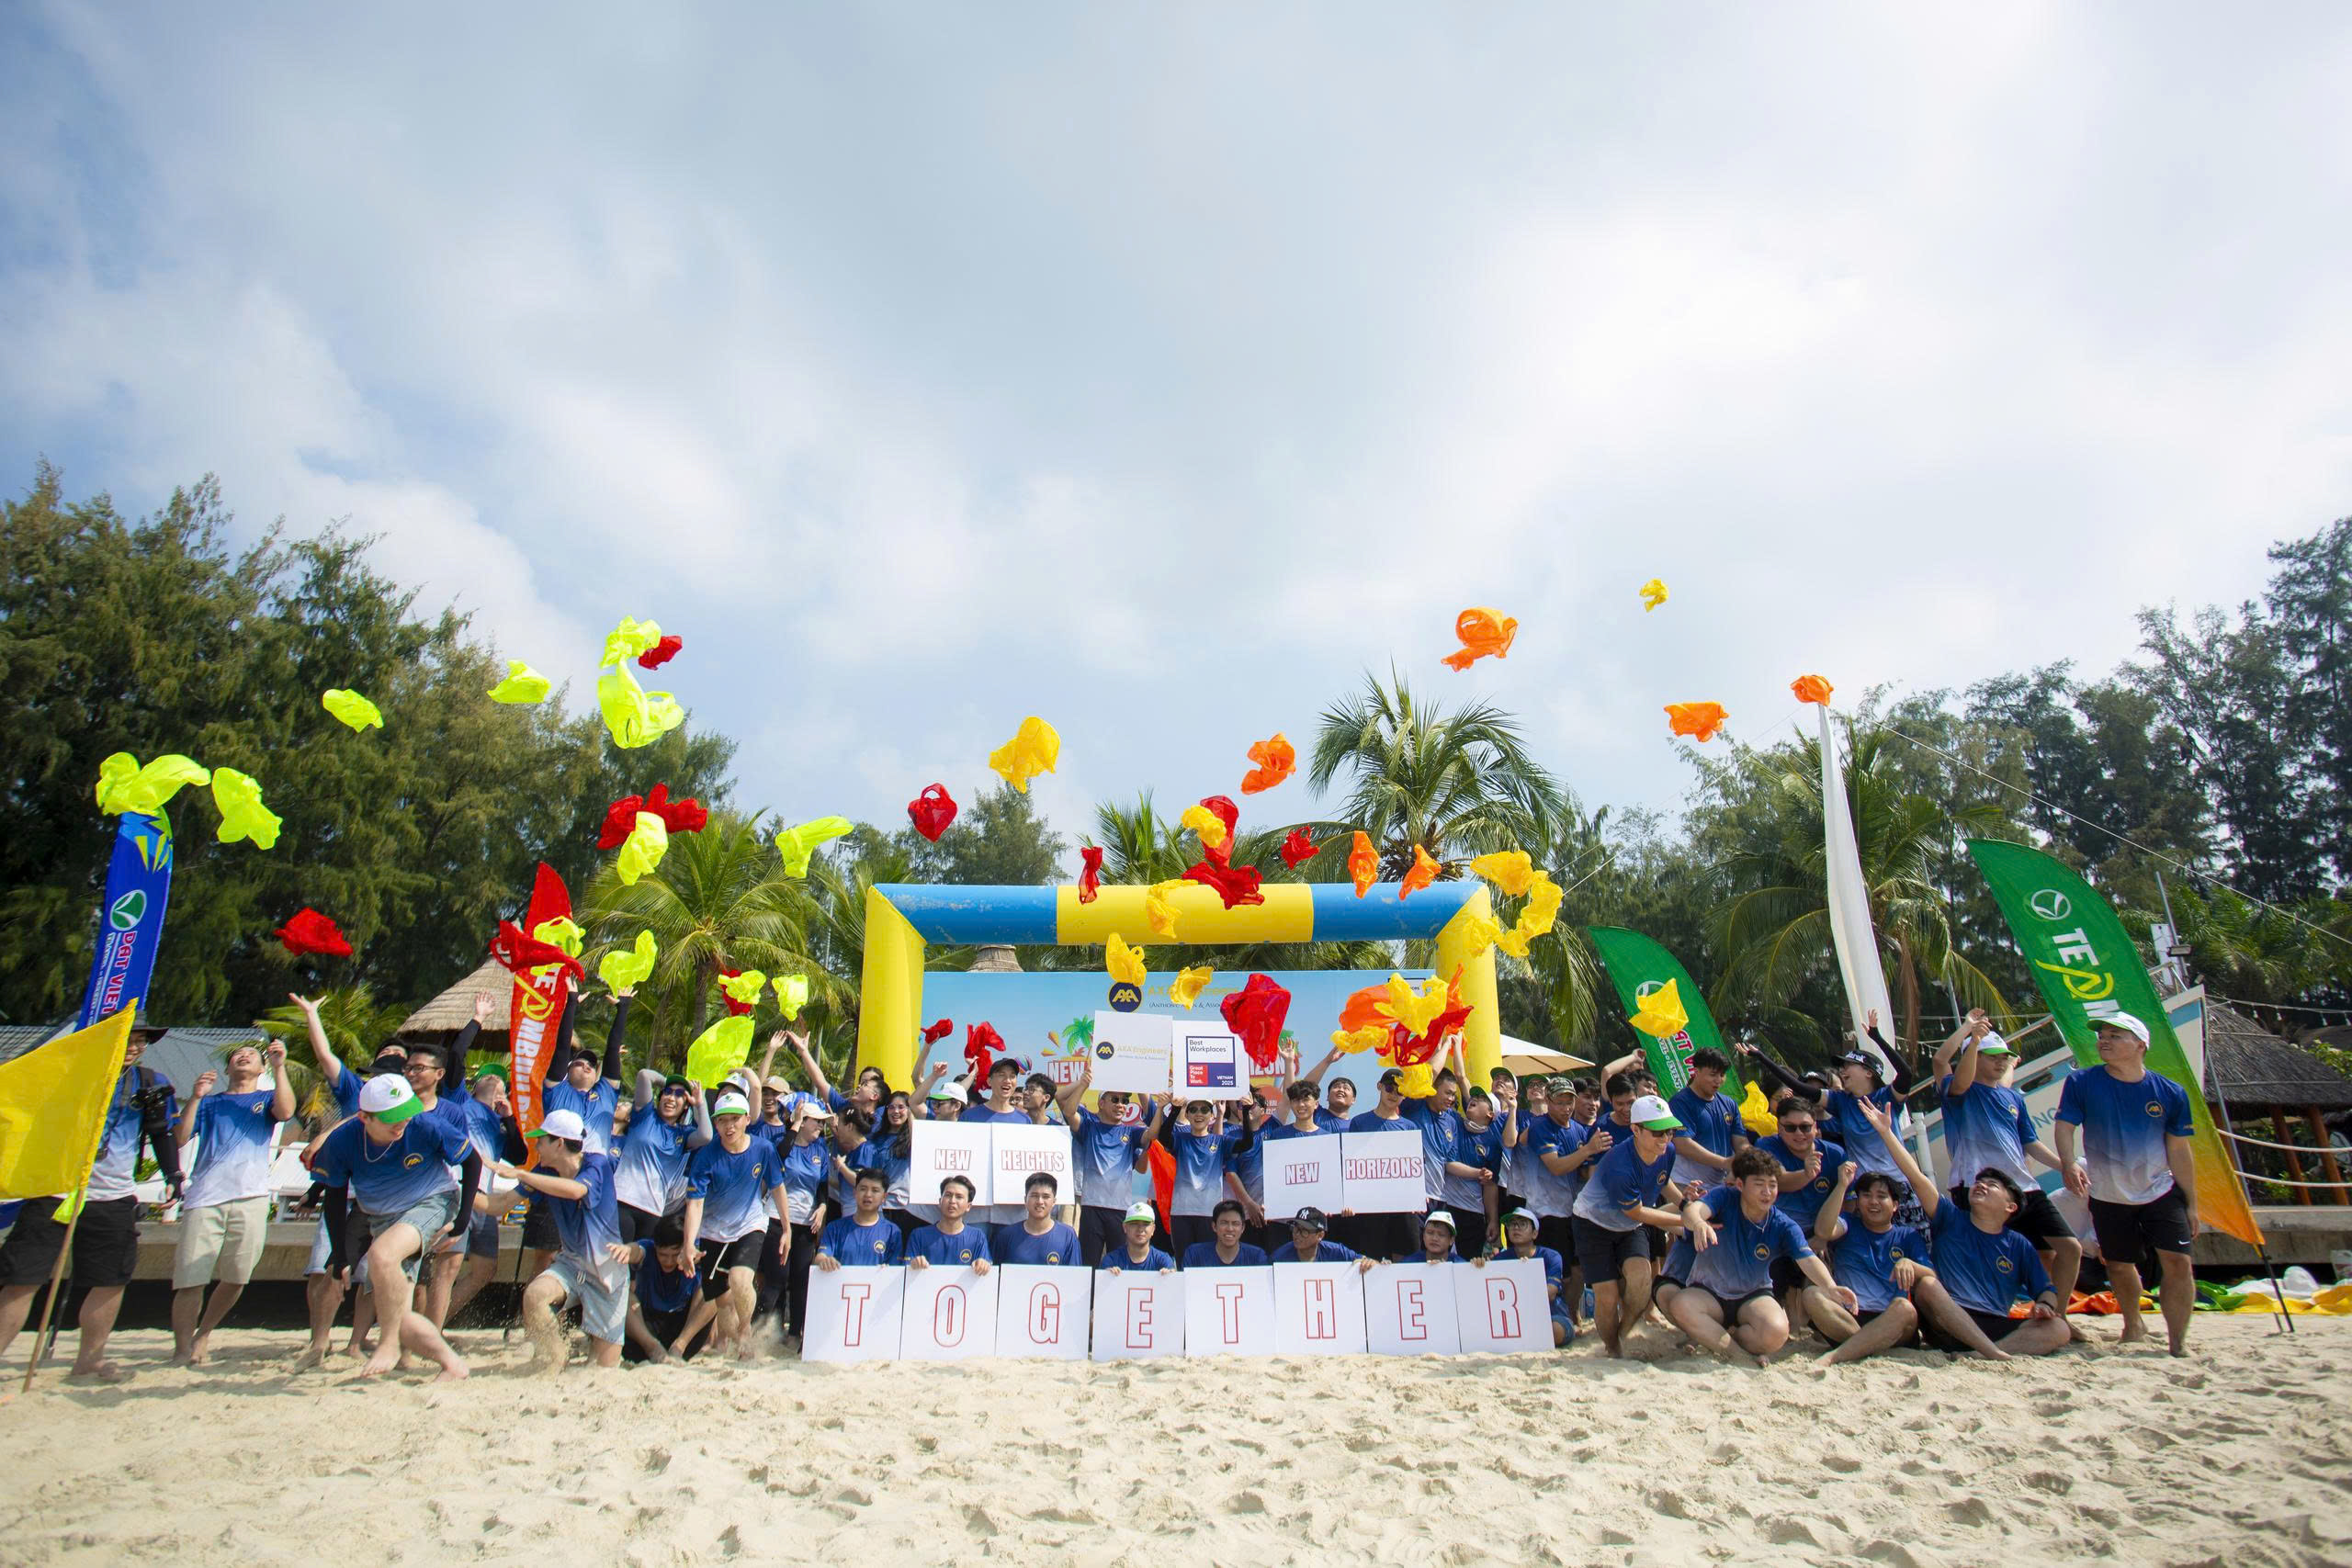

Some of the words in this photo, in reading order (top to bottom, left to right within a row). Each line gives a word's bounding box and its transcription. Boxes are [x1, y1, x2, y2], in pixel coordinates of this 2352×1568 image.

[934, 1148, 971, 1171] NEW
[1001, 1150, 1065, 1172] HEIGHTS
[1285, 1162, 1320, 1185] NEW
[1345, 1156, 1422, 1179] HORIZONS
